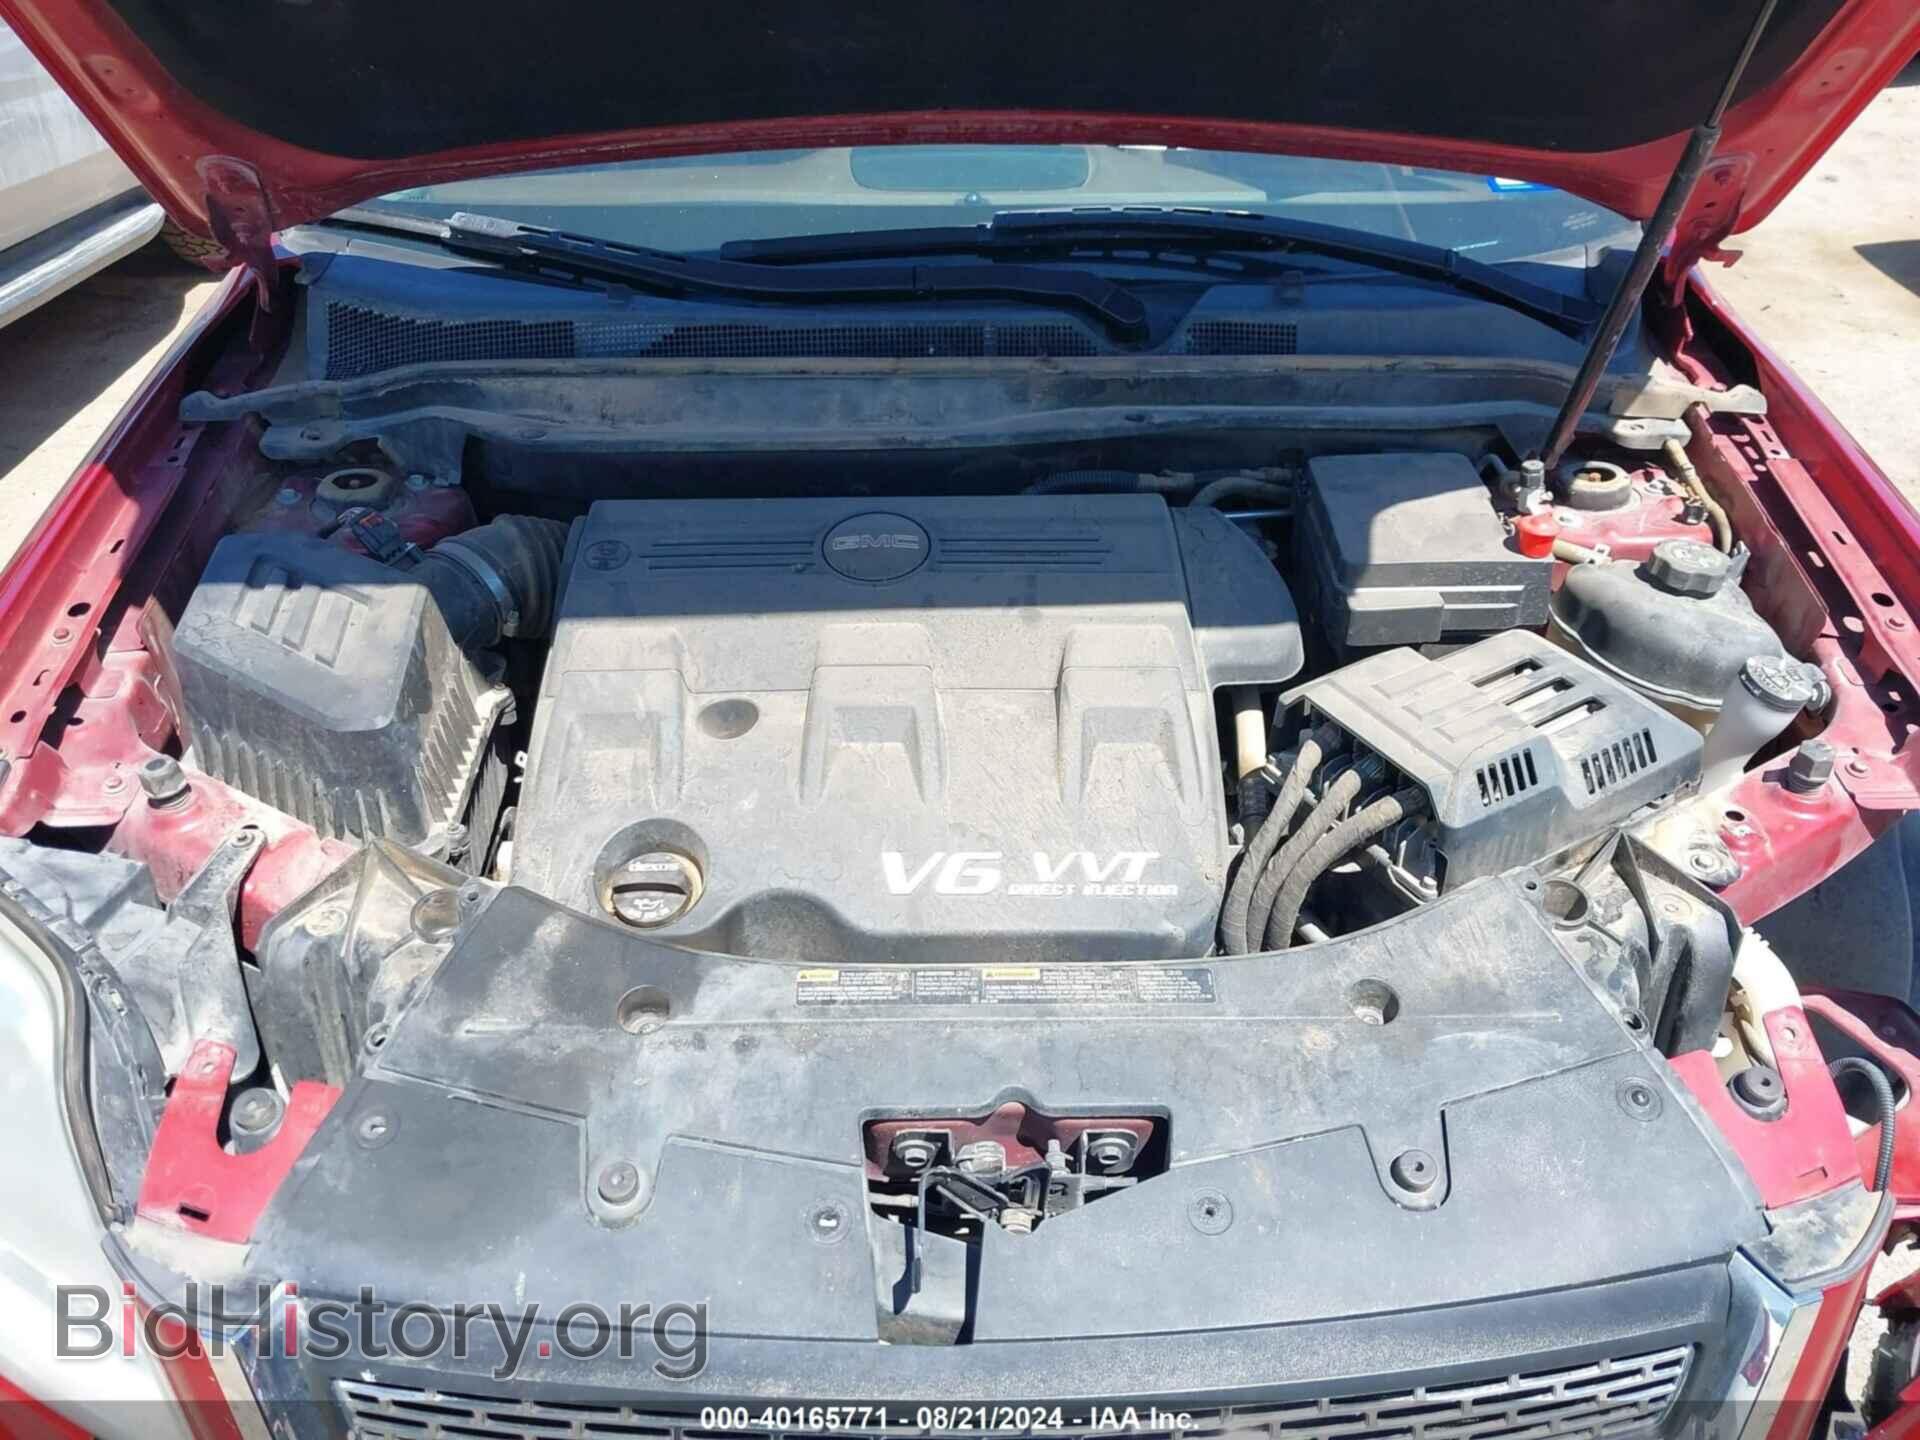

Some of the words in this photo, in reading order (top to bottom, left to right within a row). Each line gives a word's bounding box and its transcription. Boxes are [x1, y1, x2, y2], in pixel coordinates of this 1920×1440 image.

[832, 534, 919, 550] GMC
[881, 851, 1004, 895] V6
[1034, 851, 1161, 882] VVT
